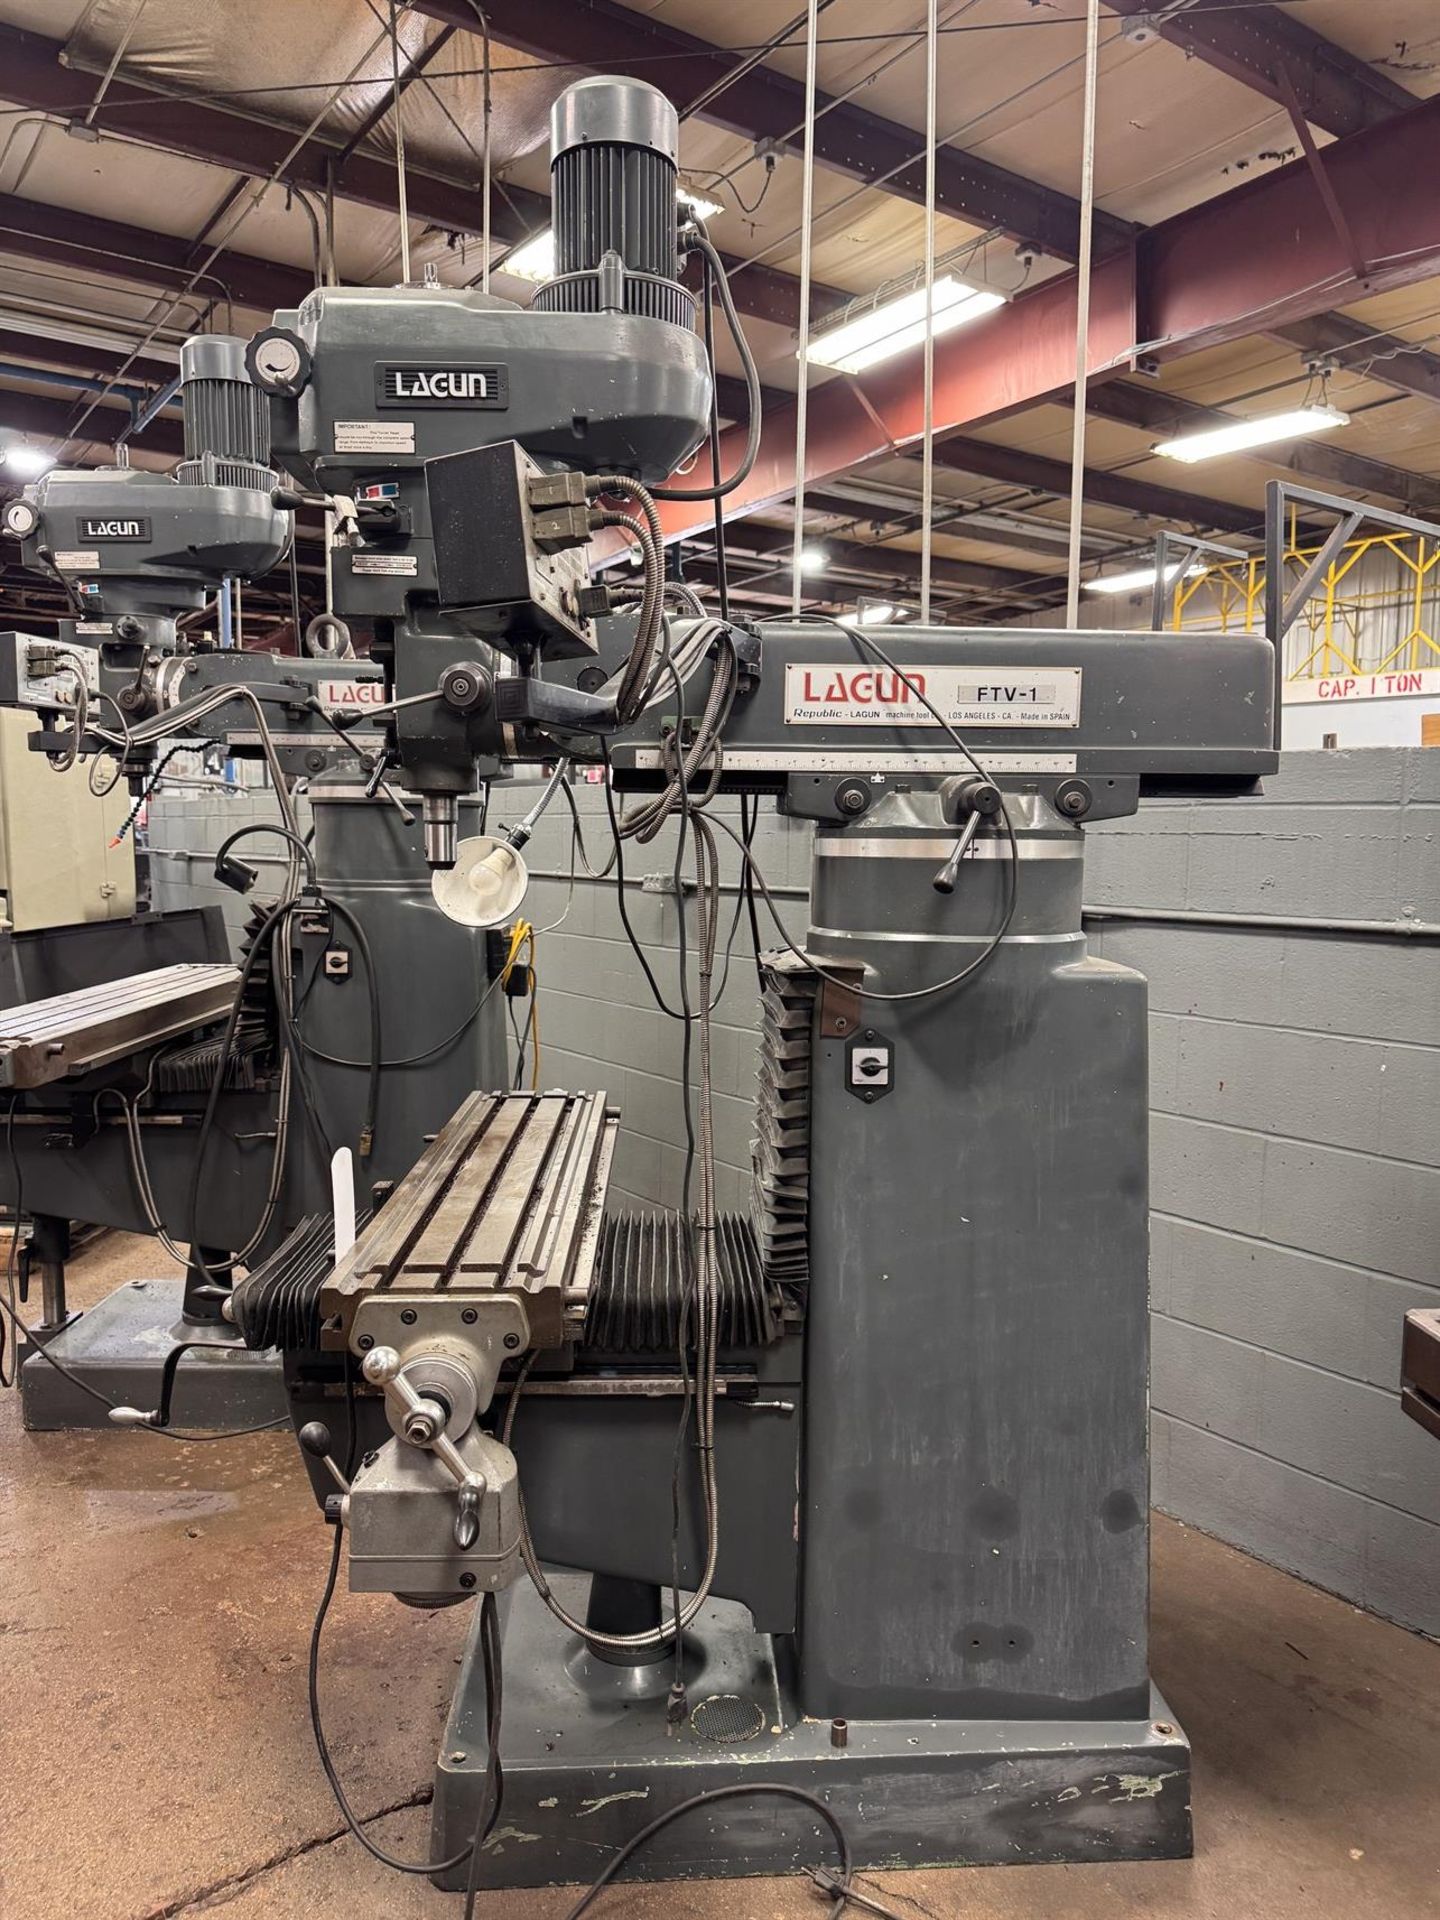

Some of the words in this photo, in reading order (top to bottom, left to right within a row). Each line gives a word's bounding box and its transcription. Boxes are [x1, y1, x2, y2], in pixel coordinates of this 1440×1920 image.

[395, 372, 487, 398] LAGUN
[87, 521, 139, 536] LAGUN
[804, 672, 926, 703] LAGUN
[1318, 679, 1360, 698] CAP.
[1384, 673, 1422, 693] TON
[329, 685, 385, 703] LAGU
[977, 687, 1037, 702] FTV-1
[793, 708, 842, 719] Republic
[948, 712, 962, 720] LOS
[964, 712, 996, 720] ANGELES
[1020, 713, 1040, 721] Made
[1041, 713, 1048, 721] in
[1049, 713, 1070, 721] SPAIN
